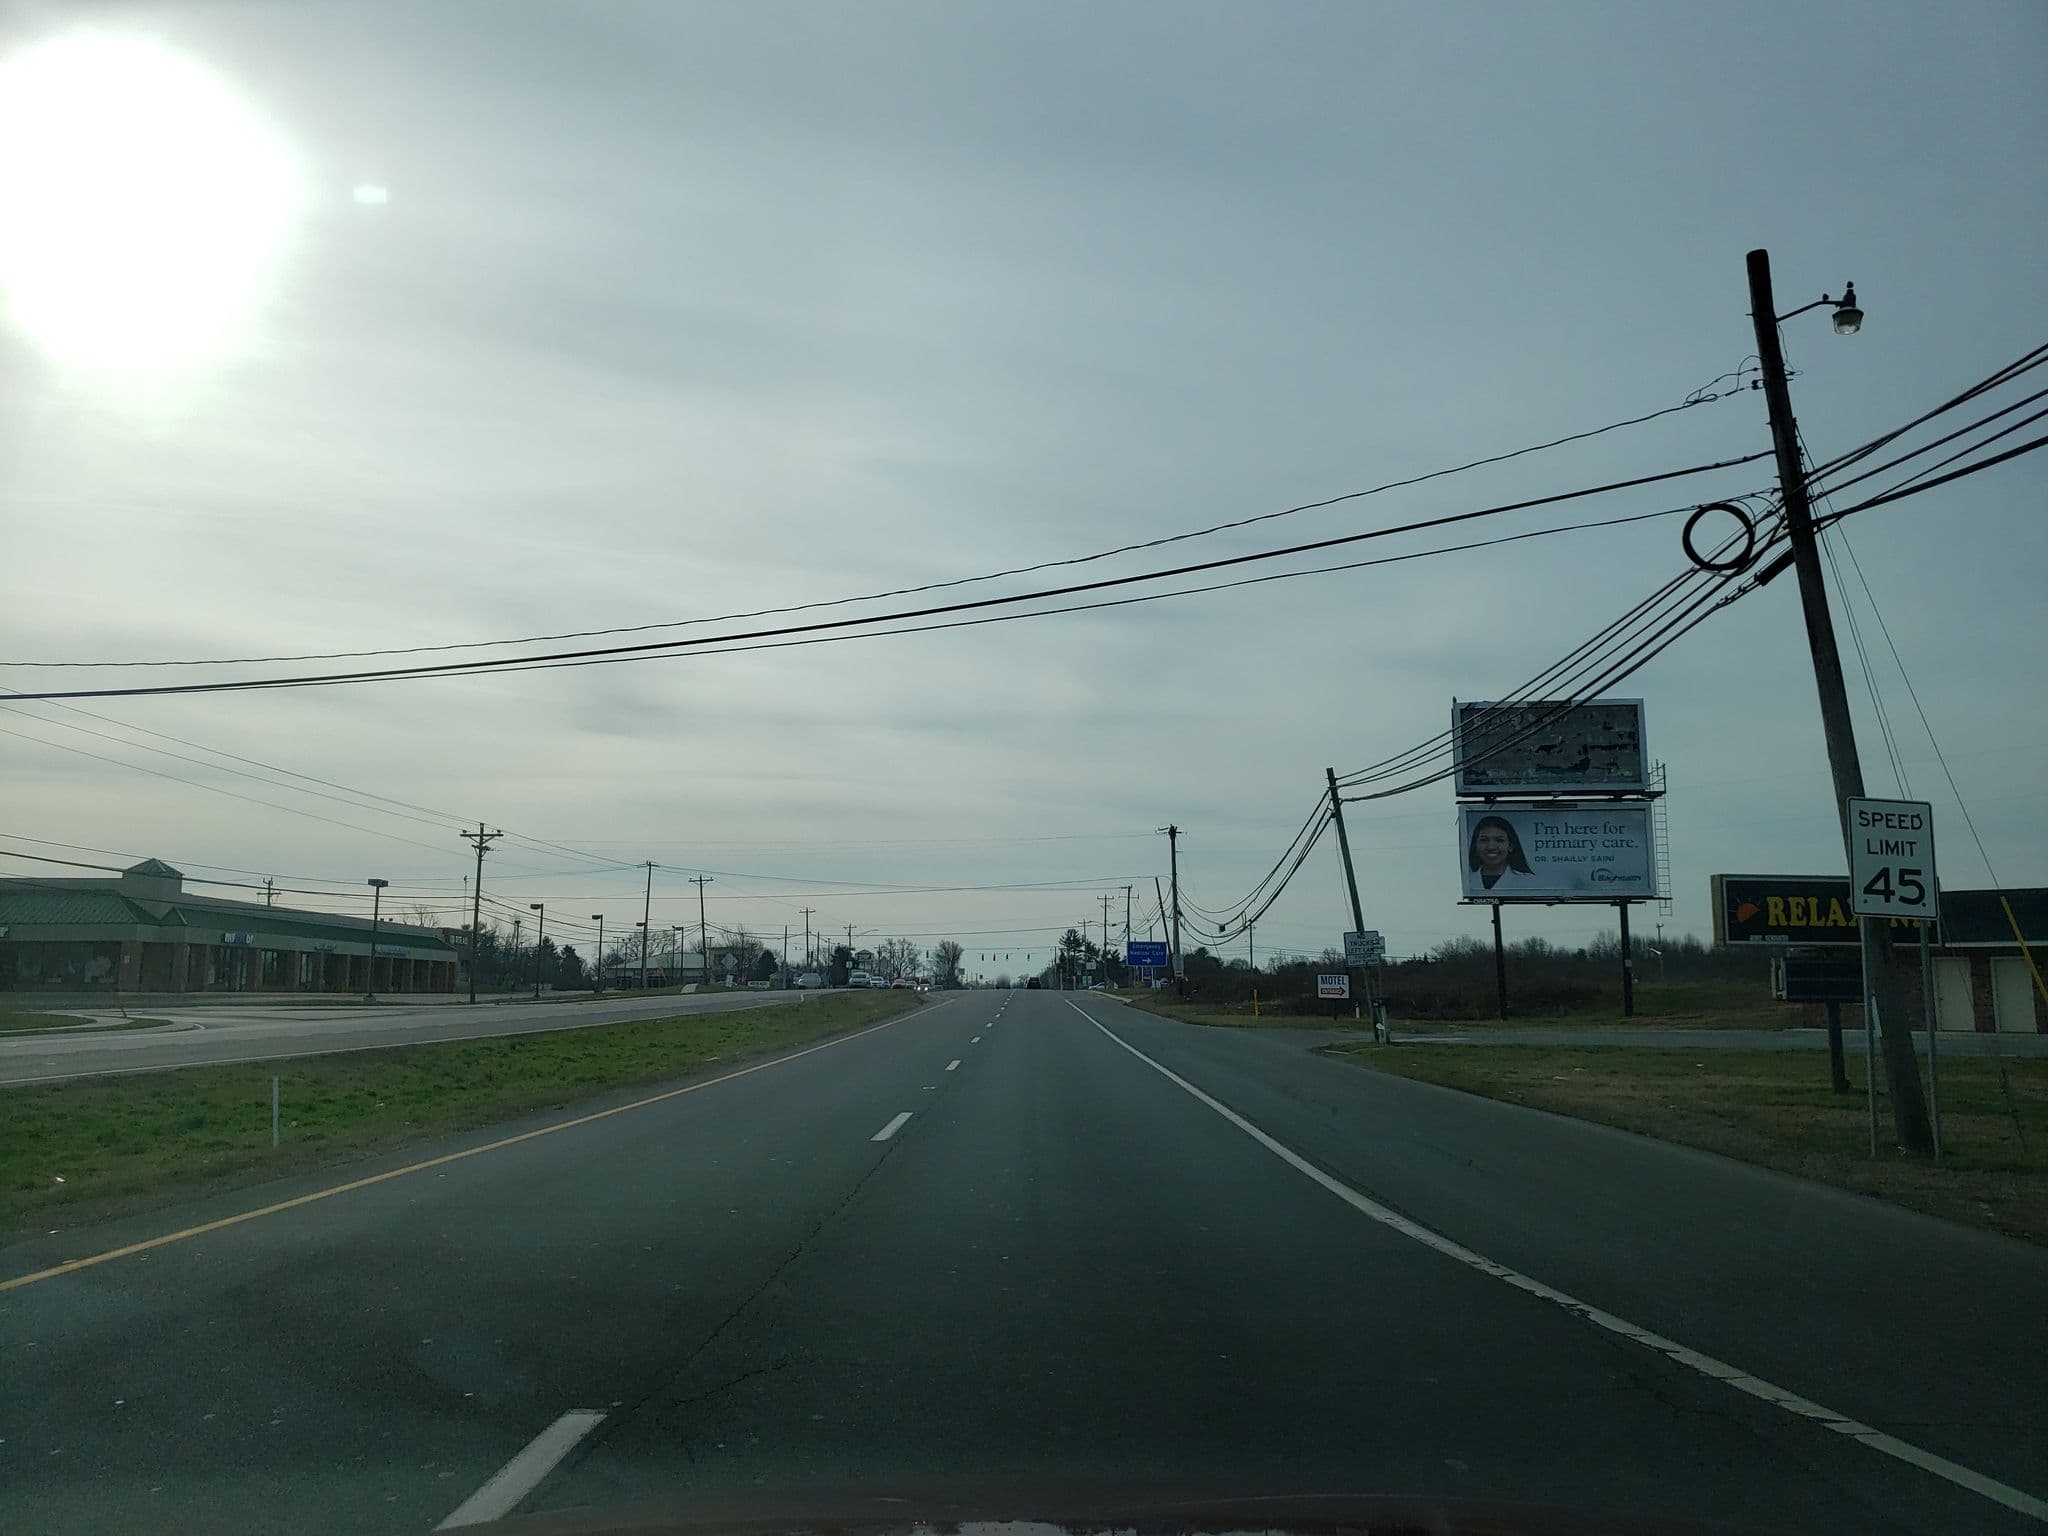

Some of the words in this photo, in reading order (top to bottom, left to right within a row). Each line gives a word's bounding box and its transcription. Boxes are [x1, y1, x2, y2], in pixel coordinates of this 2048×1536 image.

[1534, 822, 1560, 835] I'm
[1565, 822, 1598, 835] here
[1604, 821, 1625, 835] for
[1858, 809, 1924, 831] SPEED
[1534, 836, 1598, 851] primary
[1601, 839, 1640, 849] care.
[1866, 838, 1918, 857] LIMIT
[1863, 867, 1926, 904] 45
[1766, 896, 1858, 927] RELA
[1320, 975, 1347, 985] MOTEL
